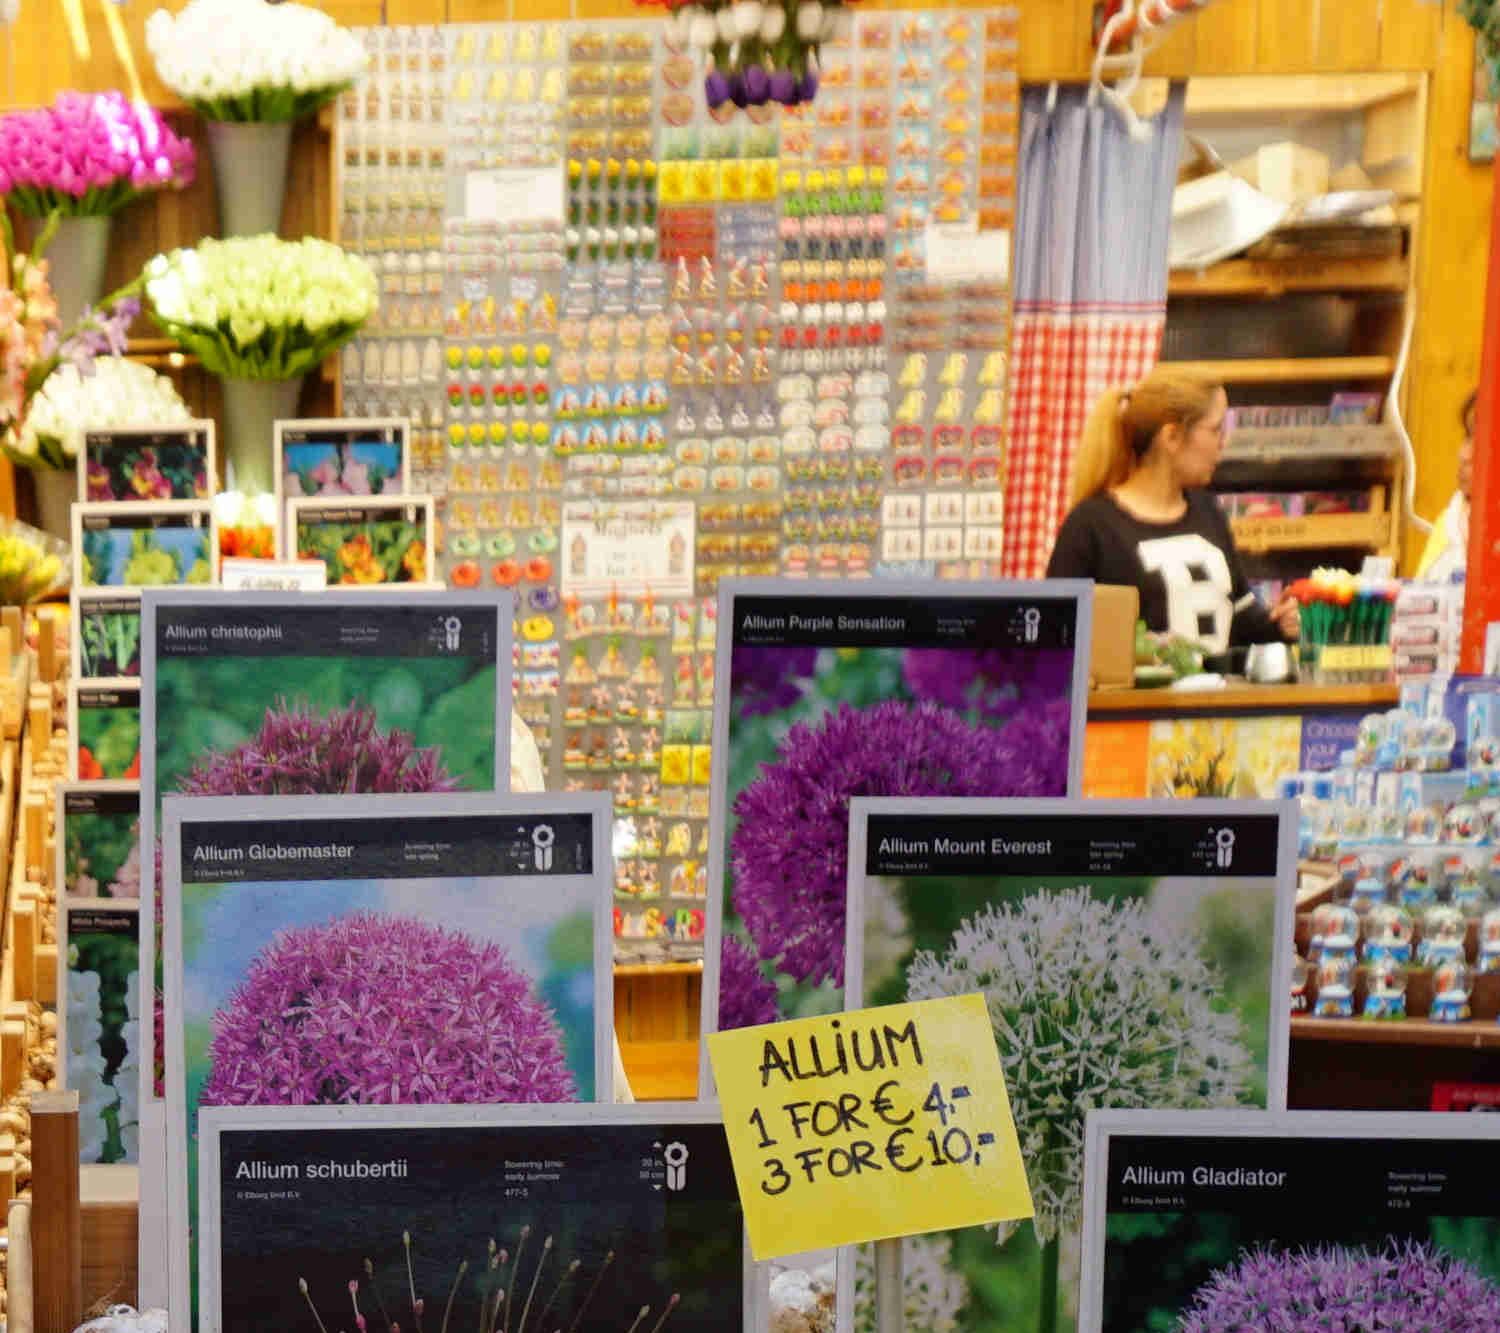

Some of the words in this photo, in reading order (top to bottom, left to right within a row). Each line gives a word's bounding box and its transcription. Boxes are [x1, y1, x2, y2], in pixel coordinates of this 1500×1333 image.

[165, 624, 207, 641] Allium
[743, 616, 786, 630] Allium
[790, 616, 834, 632] Purple
[838, 616, 905, 630] Sensation
[193, 845, 243, 861] Allium
[248, 843, 356, 861] Globemaster
[879, 838, 929, 854] Allium
[934, 838, 988, 855] Mount
[992, 838, 1052, 854] Everest
[748, 1106, 779, 1149] 1
[782, 1092, 870, 1140] FOR
[235, 1159, 299, 1180] Allium
[304, 1158, 408, 1180] schubertii
[760, 1158, 792, 1196] 3
[795, 1140, 884, 1184] FOR
[1121, 1167, 1185, 1186] Allium
[1191, 1166, 1286, 1187] Gladiator
